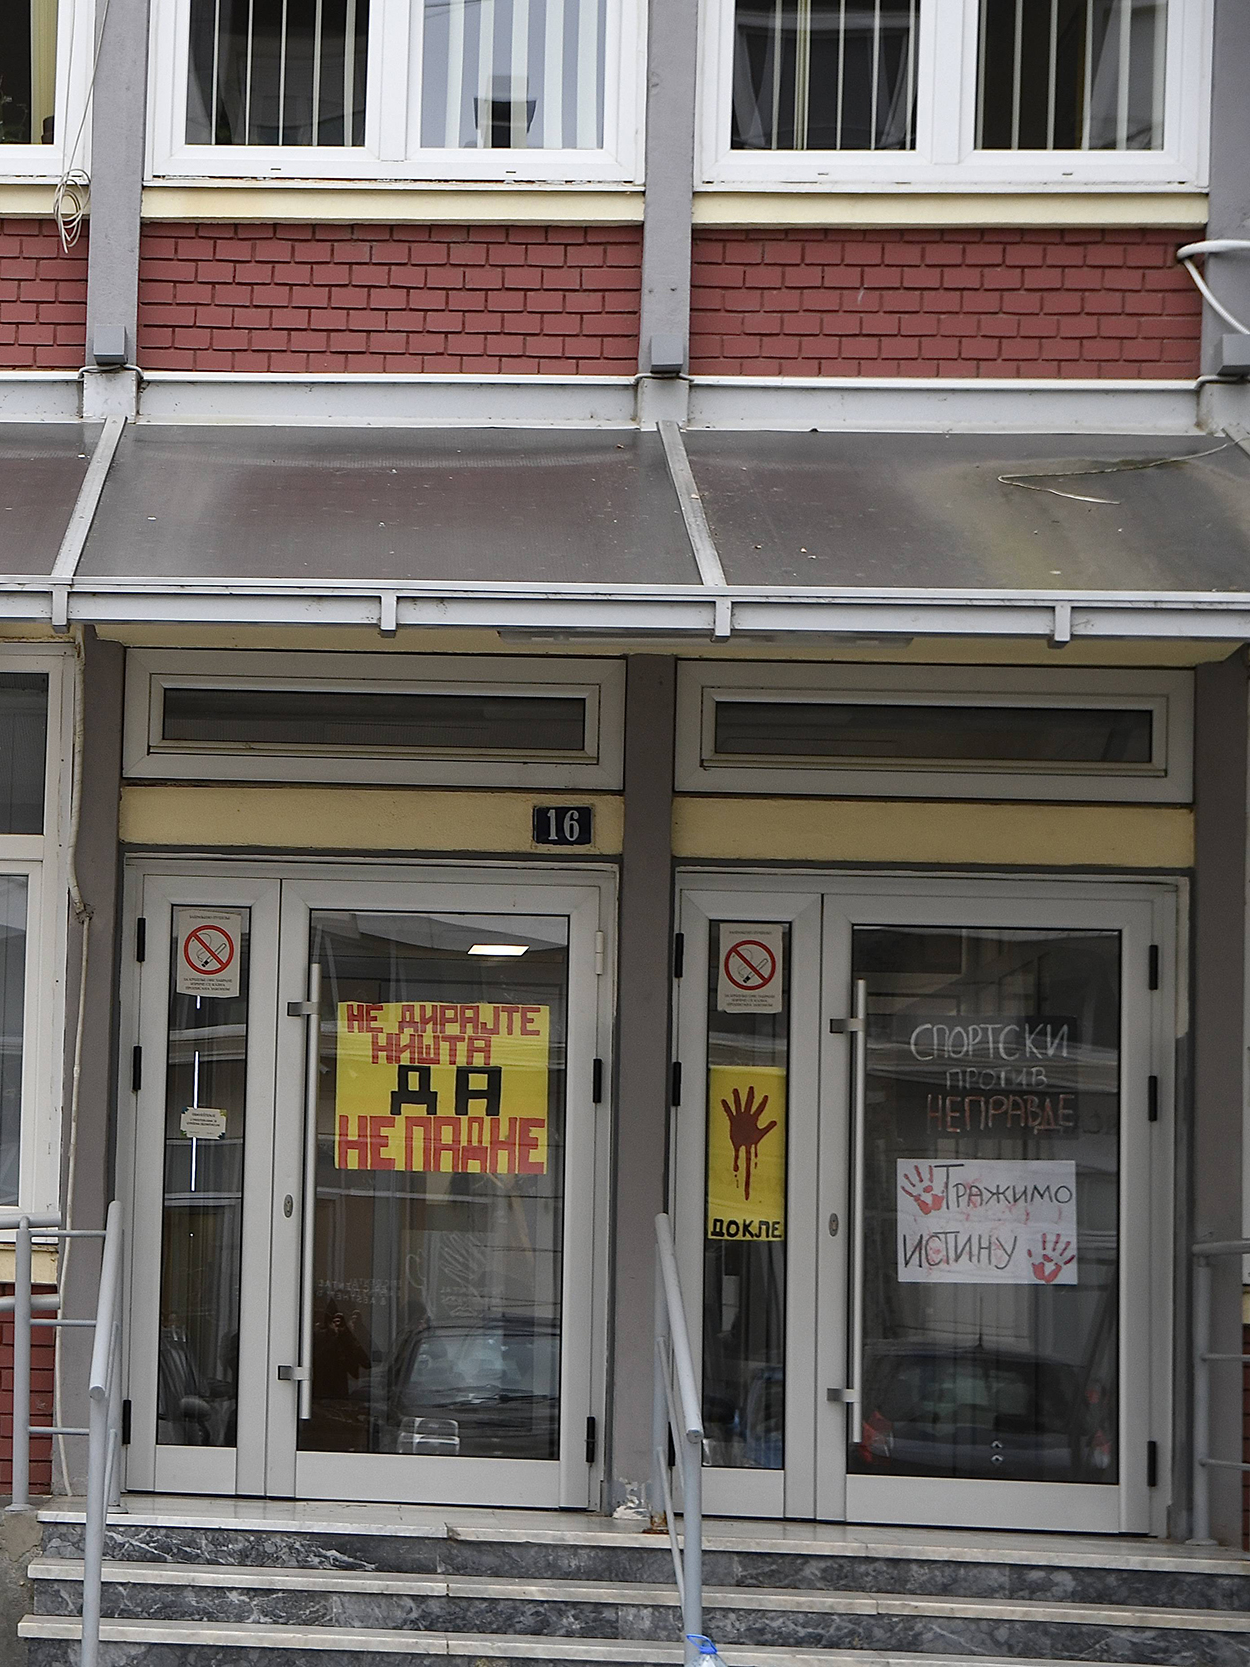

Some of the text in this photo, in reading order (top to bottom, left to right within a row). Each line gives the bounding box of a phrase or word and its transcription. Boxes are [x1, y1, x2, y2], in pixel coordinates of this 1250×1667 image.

[547, 809, 580, 841] 16
[347, 1004, 541, 1036] НЕ ДИРАЈТЕ
[371, 1033, 492, 1065] НИШТА
[910, 1022, 1069, 1060] СПОРТСКИ
[946, 1066, 1048, 1090] ПРОТИВ
[926, 1093, 1076, 1134] НЕПРАВДЕ
[338, 1114, 546, 1174] НЕ ПАДНЕ
[710, 1218, 782, 1238] ДОКЛЕ
[903, 1231, 1017, 1270] ИСТИНУ
